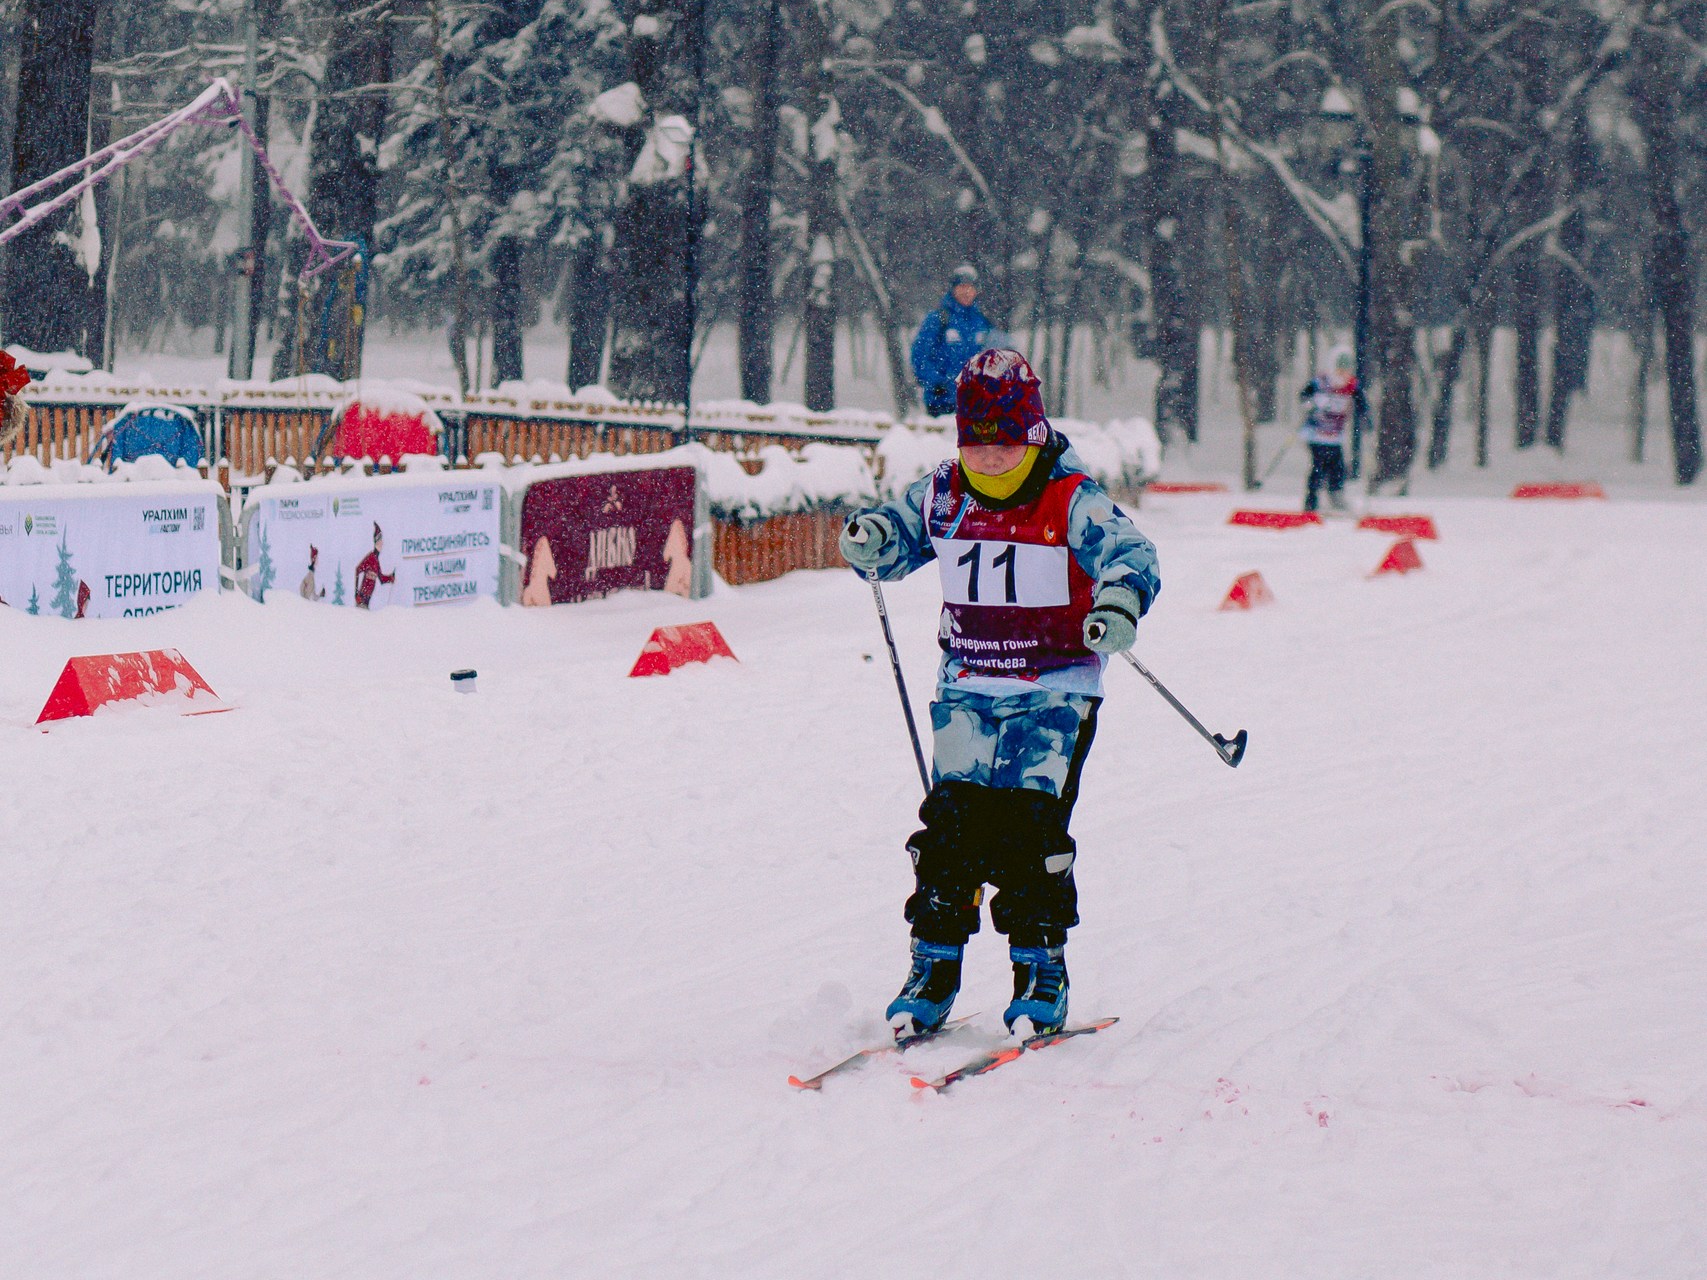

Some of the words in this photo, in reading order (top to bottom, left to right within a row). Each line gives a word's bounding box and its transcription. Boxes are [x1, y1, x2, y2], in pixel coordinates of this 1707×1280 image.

[142, 508, 187, 522] УРАЛХИМ
[401, 531, 490, 554] ПРИСОЕДИНЯЙТЕСЬ
[424, 562, 430, 576] К
[432, 558, 466, 575] НАШИМ
[957, 542, 1017, 604] 11
[105, 568, 202, 598] ТЕРРИТОРИЯ
[413, 581, 477, 601] ТРЕНИРОВКАМ
[950, 633, 1000, 653] Вечерняя
